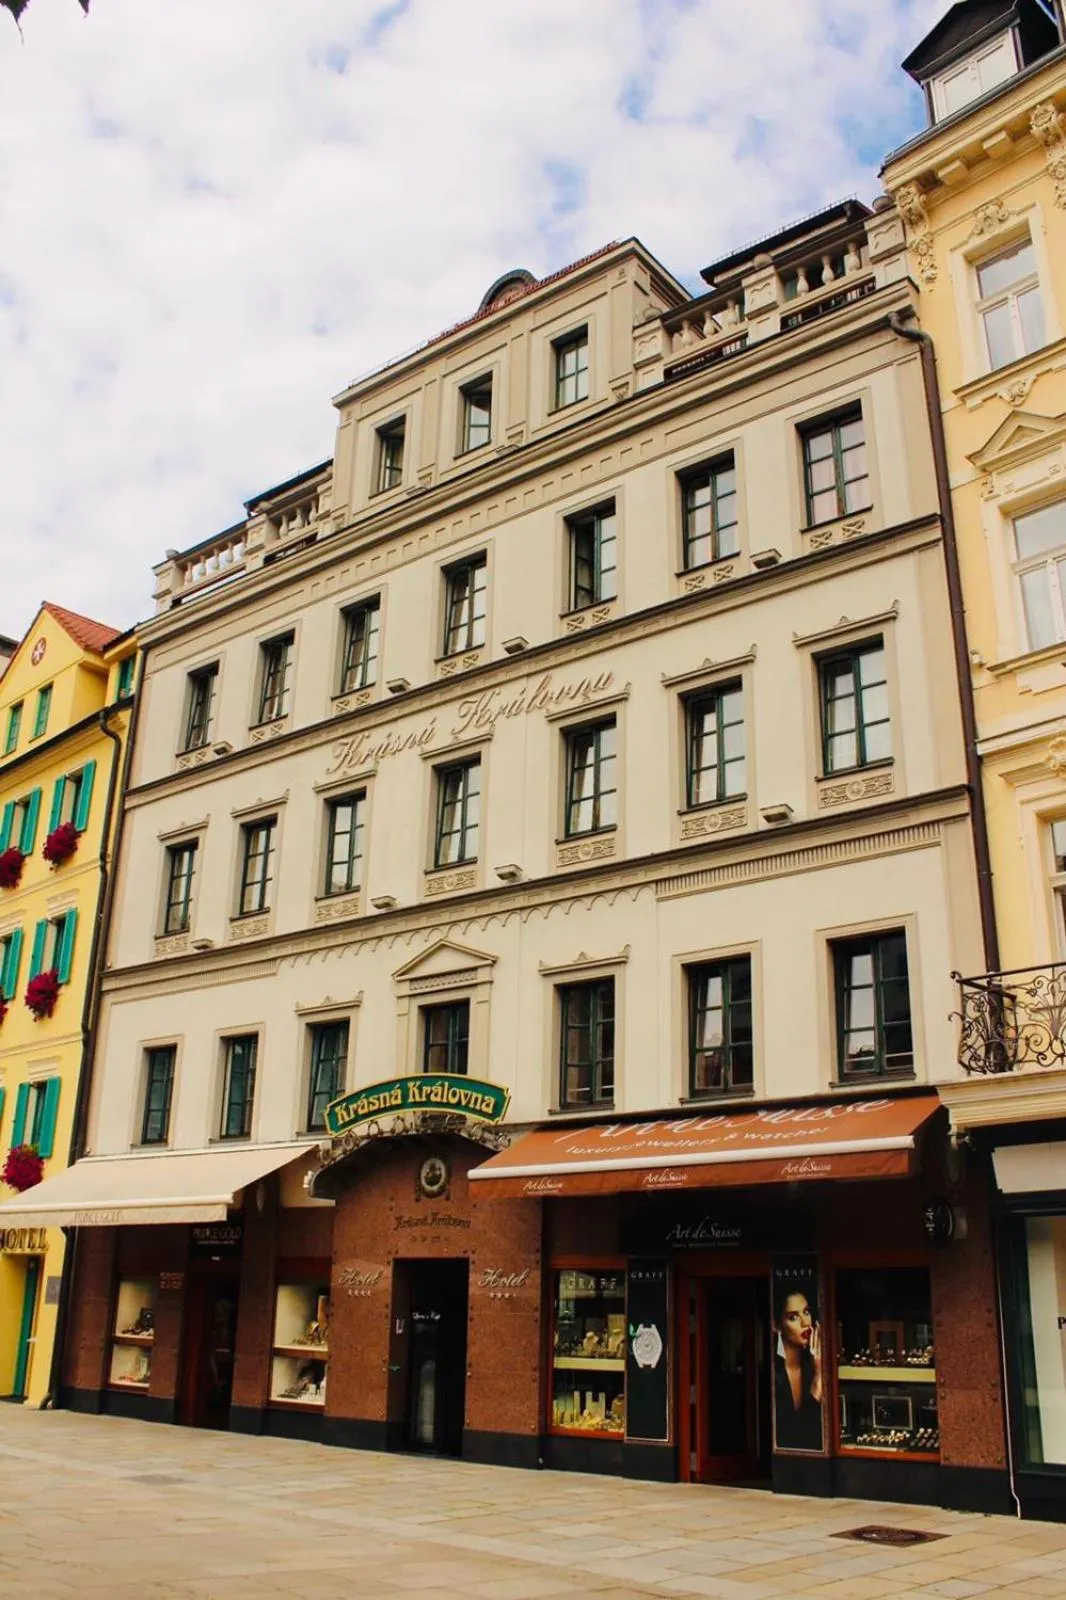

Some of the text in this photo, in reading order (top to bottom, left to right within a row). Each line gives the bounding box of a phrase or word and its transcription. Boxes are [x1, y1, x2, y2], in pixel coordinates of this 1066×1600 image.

[334, 1081, 496, 1126] Krásná Královna
[665, 1223, 691, 1240] Art
[710, 1222, 742, 1239] Suisse
[337, 1267, 383, 1286] Hotel
[478, 1268, 530, 1287] Hotel
